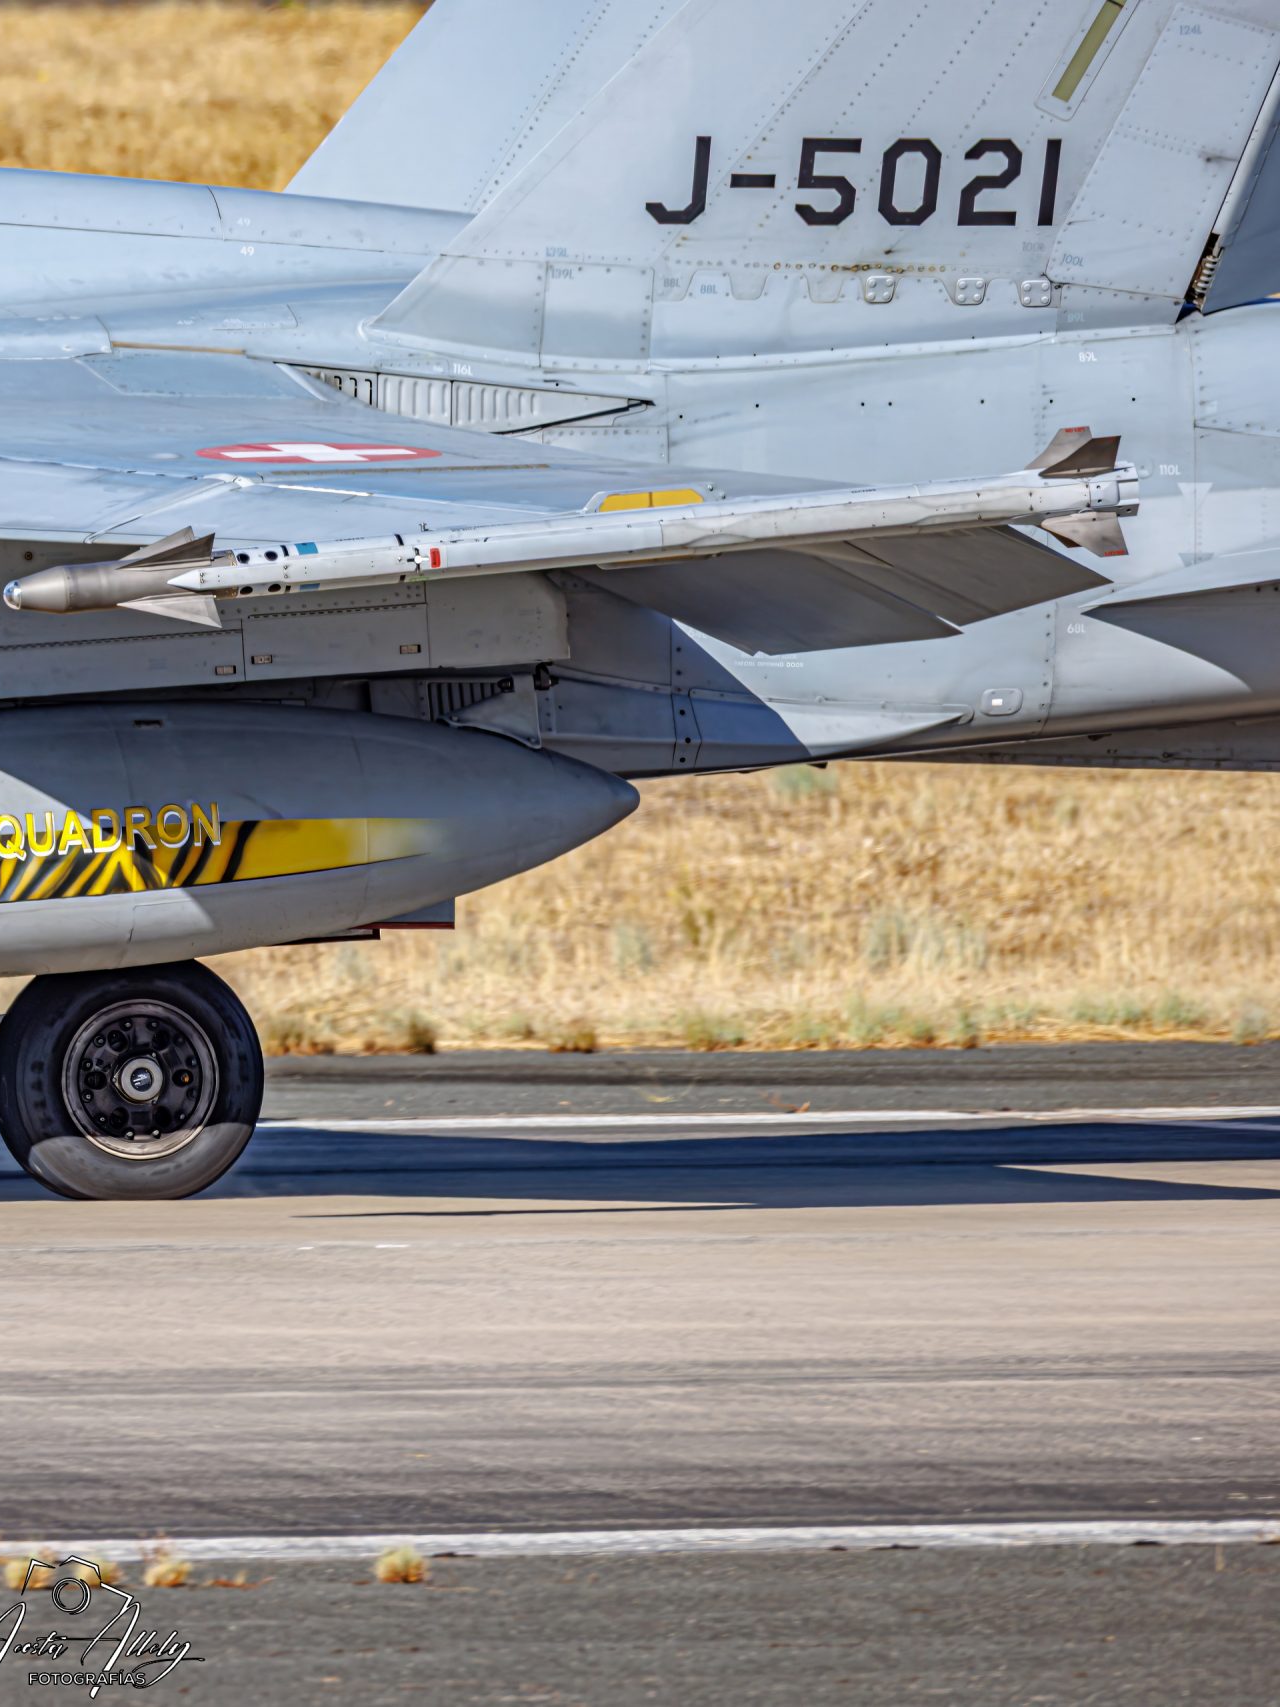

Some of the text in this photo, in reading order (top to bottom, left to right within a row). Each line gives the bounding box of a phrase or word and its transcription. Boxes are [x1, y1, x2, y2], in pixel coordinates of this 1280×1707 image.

[645, 135, 1062, 226] J-5021
[240, 246, 255, 257] 49
[1078, 350, 1098, 363] 89L
[1159, 463, 1182, 476] 110L
